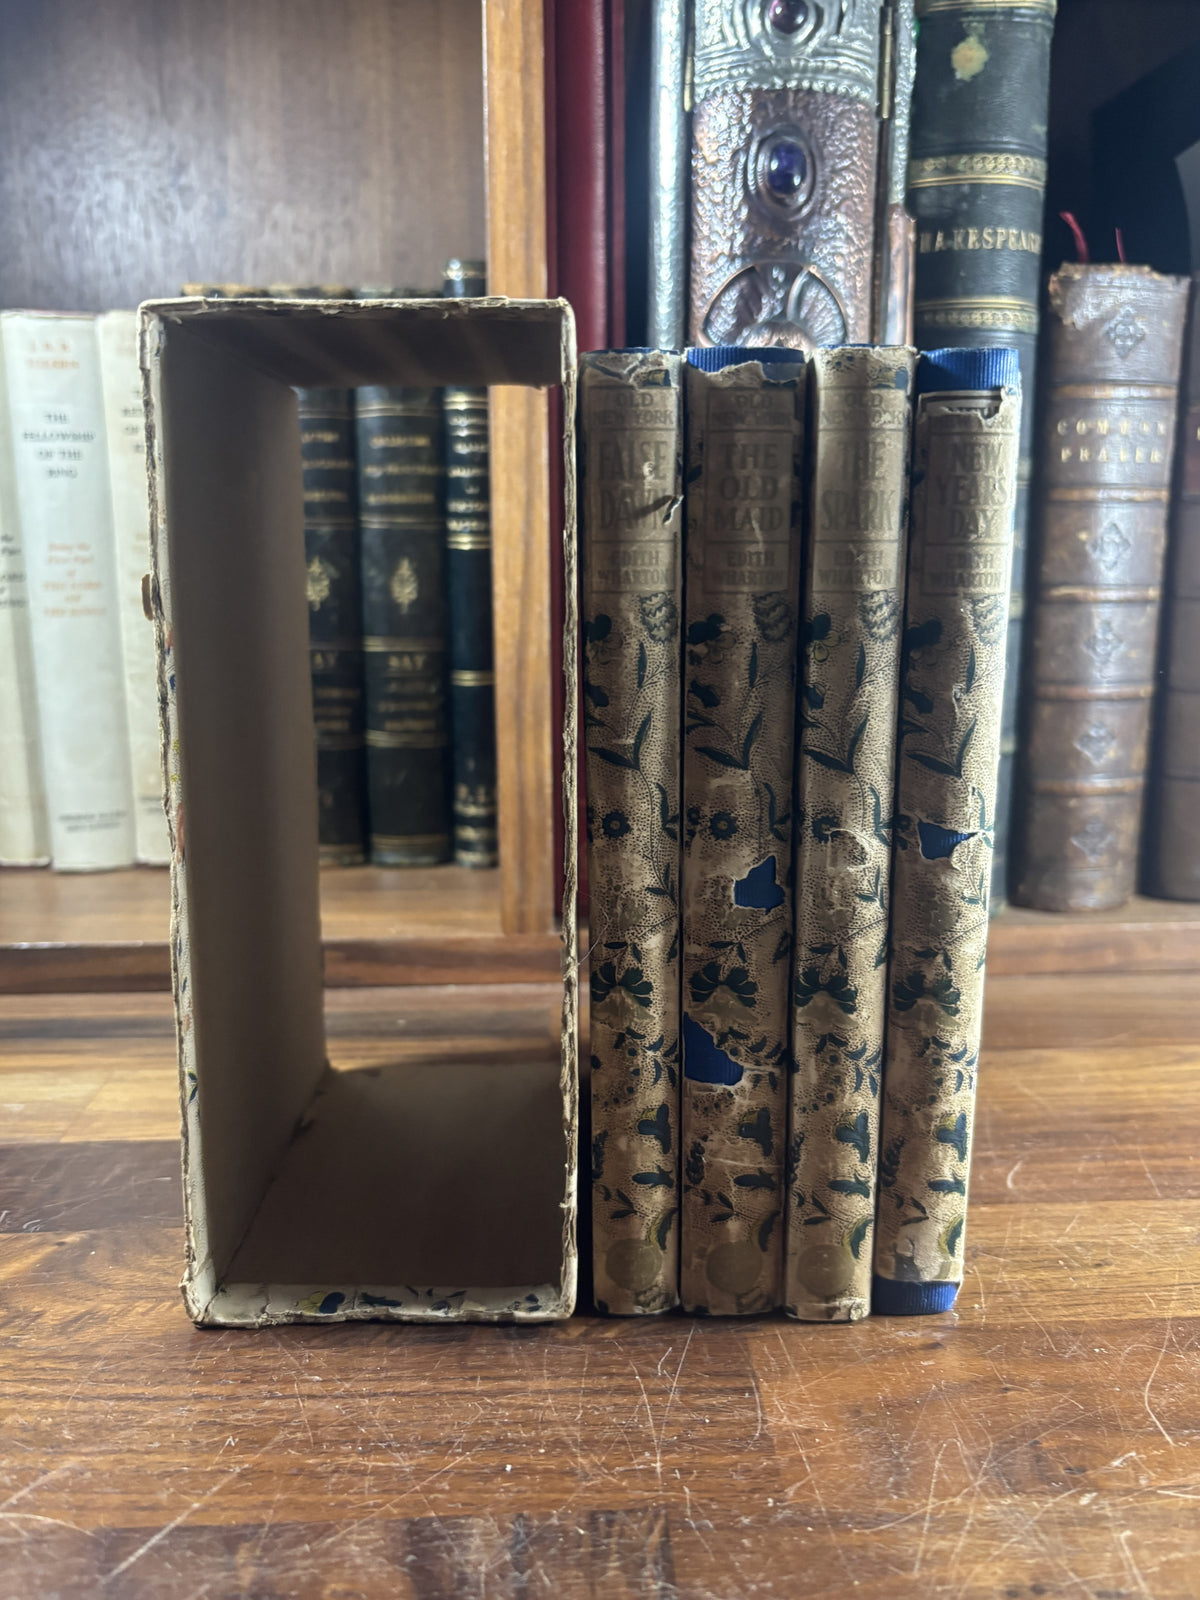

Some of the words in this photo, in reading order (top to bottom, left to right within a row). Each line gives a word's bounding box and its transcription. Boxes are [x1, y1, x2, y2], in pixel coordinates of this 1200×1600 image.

[919, 225, 1042, 254] HAKESPEAR
[616, 392, 653, 408] OLD
[735, 394, 773, 409] OLD
[844, 393, 883, 408] OLD
[635, 409, 673, 425] YORK
[599, 441, 667, 480] FALSE
[720, 443, 778, 470] THE
[839, 441, 886, 480] THE
[948, 442, 1002, 472] NEW
[719, 476, 778, 500] OLD
[715, 507, 783, 531] MAID
[822, 490, 895, 531] SPARK
[951, 508, 998, 539] DAY
[611, 550, 659, 566] EDITH
[727, 551, 775, 567] EDITH
[819, 569, 892, 585] WHARTON
